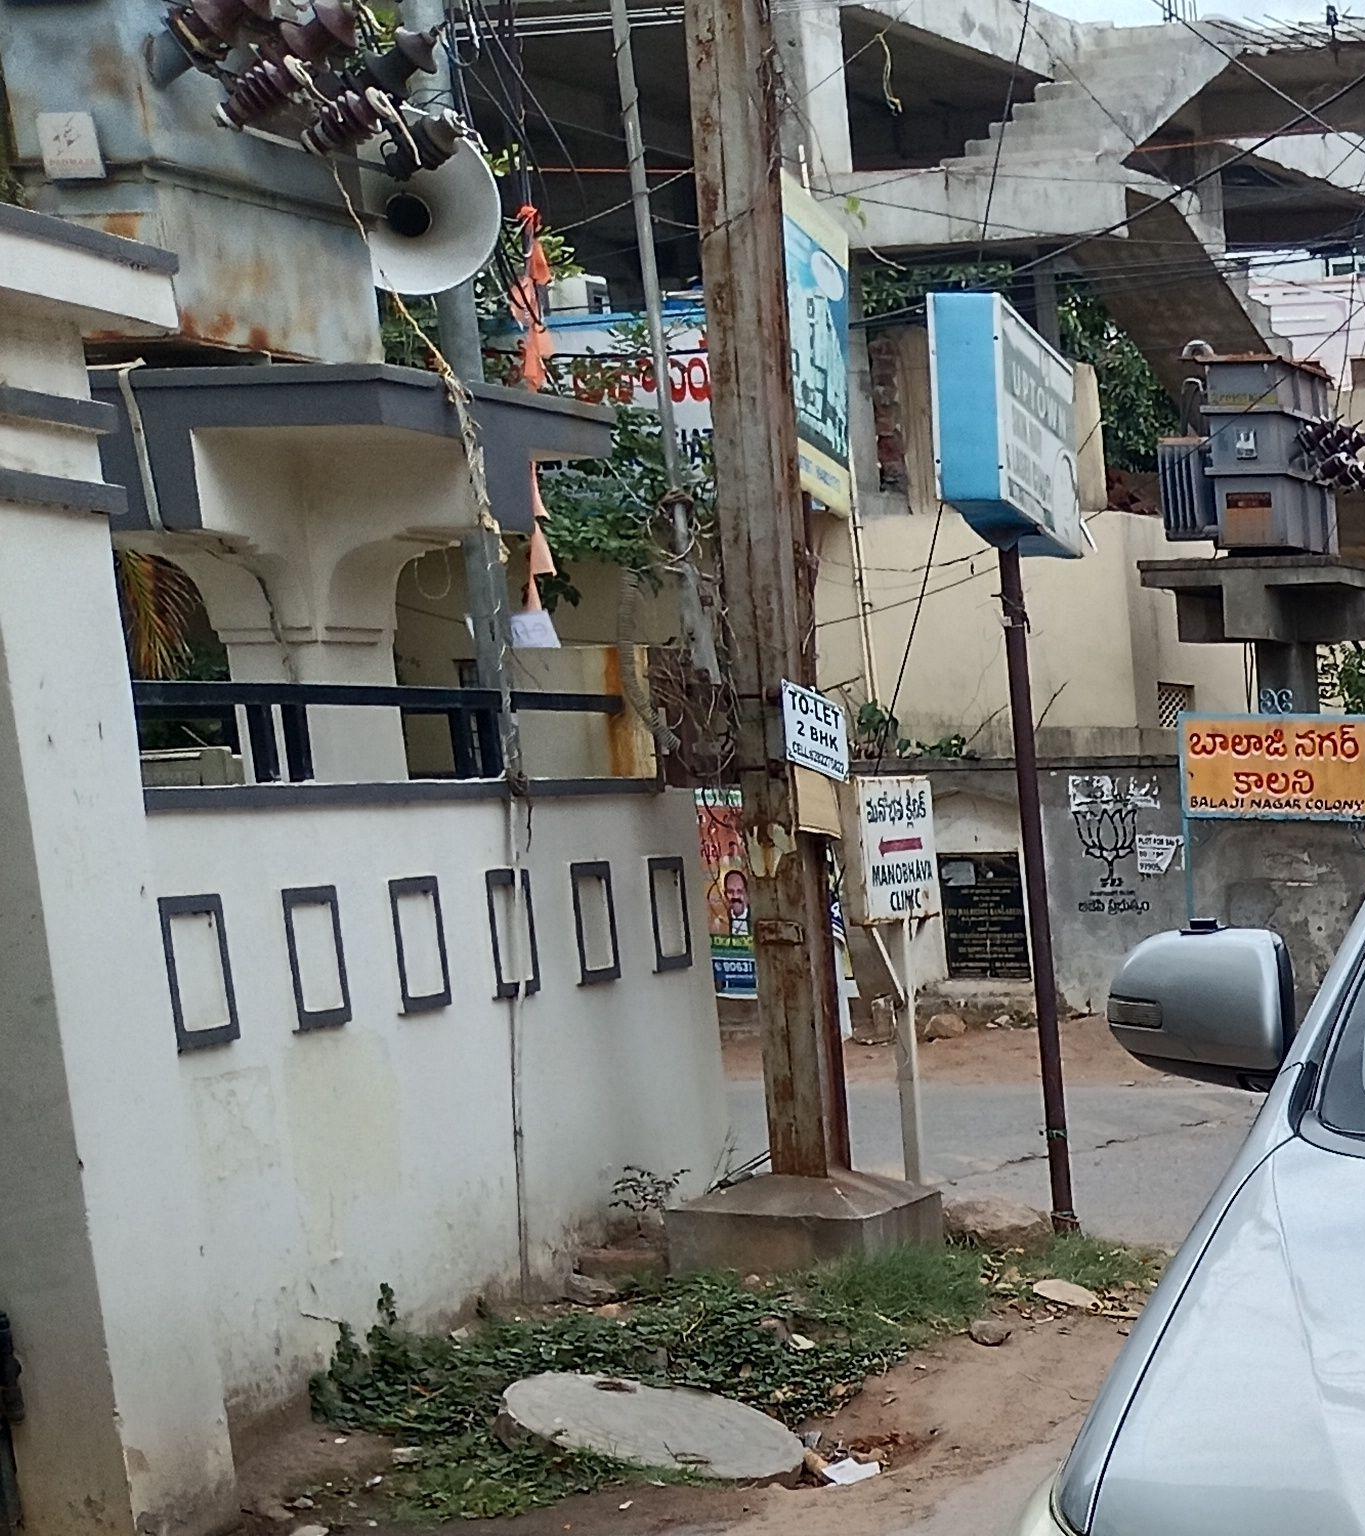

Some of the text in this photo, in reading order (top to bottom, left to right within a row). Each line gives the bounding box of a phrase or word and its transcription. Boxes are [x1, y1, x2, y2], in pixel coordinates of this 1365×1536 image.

[1012, 360, 1068, 440] UPTOWN
[796, 720, 839, 752] 2 BHK
[1189, 724, 1360, 761] బాలాజి నగర్
[1232, 769, 1315, 796] కాలని
[1190, 796, 1365, 811] BALAJI NAGAR COLONY
[872, 859, 934, 887] MANOBHAVA
